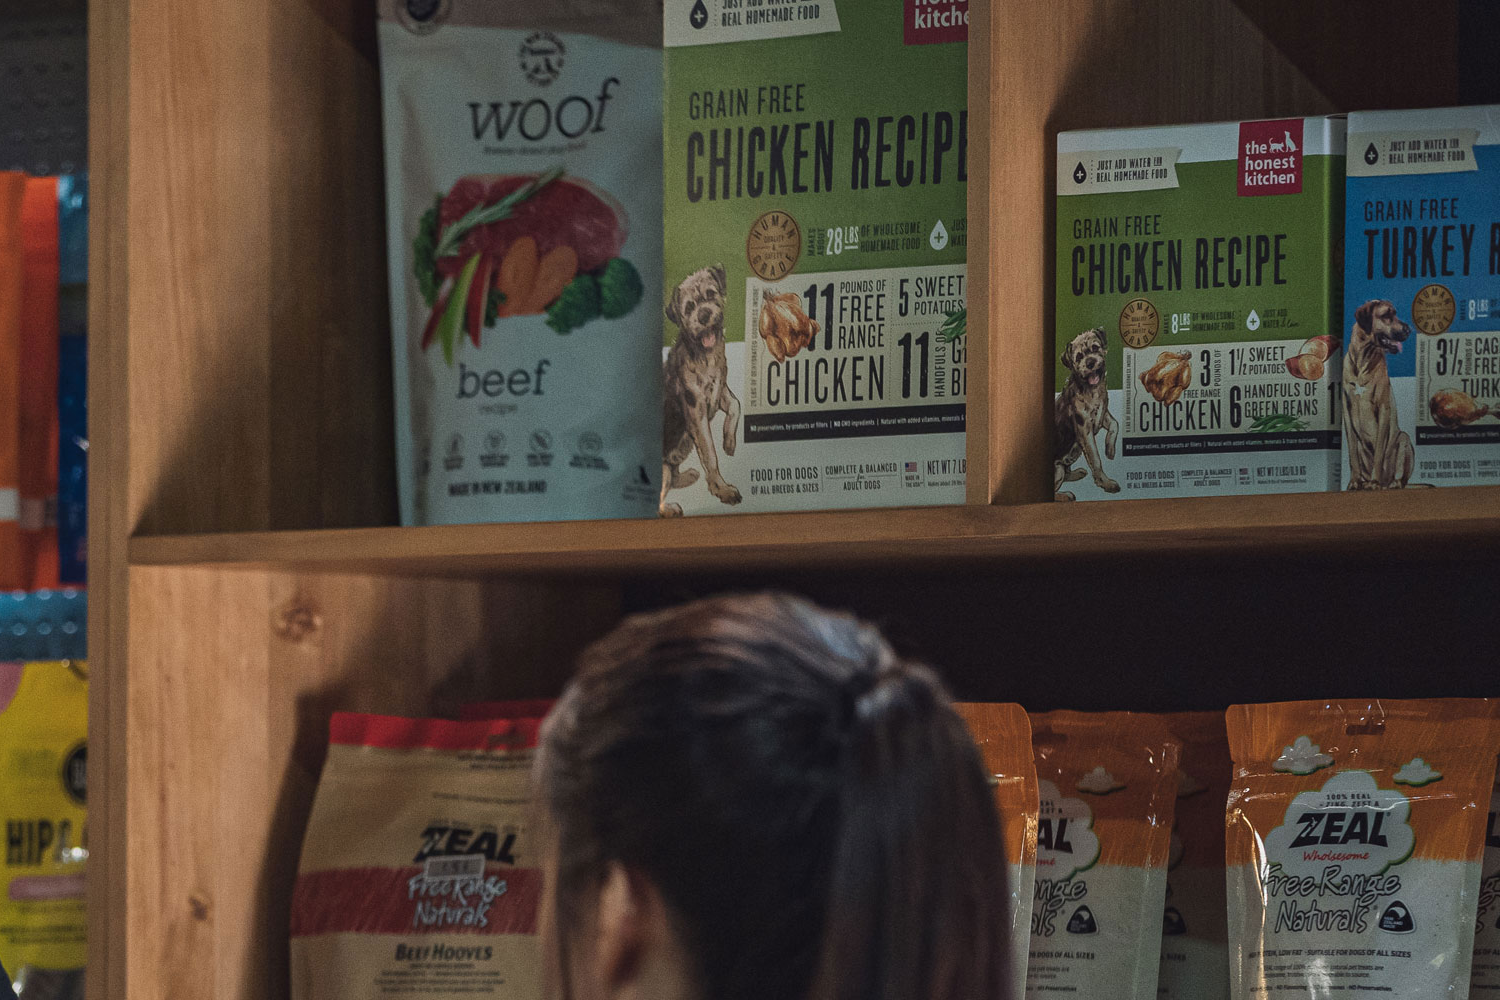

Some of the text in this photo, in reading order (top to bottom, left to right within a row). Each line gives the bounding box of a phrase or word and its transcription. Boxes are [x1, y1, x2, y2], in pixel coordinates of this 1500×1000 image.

[722, 5, 820, 27] REAL HOMEMADE FOOD
[467, 77, 620, 141] woof
[689, 84, 806, 121] GRAIN FREE
[1245, 141, 1267, 155] the
[1389, 139, 1447, 152] JUST ADD WATER
[687, 119, 834, 203] CHICKEN
[1097, 157, 1151, 170] JUST ADD WATER
[1245, 155, 1295, 171] honest
[1389, 151, 1465, 164] REAL HOMEMADE FOOD
[1097, 169, 1167, 182] REAL HOMEMADE FOOD
[1245, 171, 1295, 186] kitchen
[1364, 198, 1459, 222] GRAIN FREE
[753, 215, 796, 241] HUMAN
[844, 225, 859, 244] LBS
[861, 221, 921, 236] OF WHOLESOME
[1073, 215, 1161, 239] GRAIN FREE
[826, 227, 843, 255] 28
[860, 237, 921, 253] HOMEMADE FOOD
[1364, 224, 1475, 280] TURKEY
[752, 254, 796, 278] GRADE
[1072, 234, 1287, 297] CHICKEN RECIPE
[840, 279, 886, 293] POUNDS OF
[914, 275, 964, 298] SWEET
[1418, 288, 1451, 305] HUMAN
[899, 279, 909, 317] 5
[914, 299, 964, 316] POTATOES
[804, 283, 835, 351] 11
[839, 294, 886, 324] FREE
[1124, 303, 1155, 320] HUMAN
[1179, 312, 1190, 326] LBS
[1469, 299, 1475, 320] 8
[1171, 313, 1178, 334] 8
[838, 324, 885, 349] RANGE
[1124, 329, 1154, 345] GRADE
[1214, 350, 1221, 359] OF
[1249, 346, 1286, 361] SWEET
[898, 331, 930, 399] 11
[935, 345, 945, 398] HANDFULS
[1201, 350, 1211, 387] 3
[1249, 362, 1286, 375] POTATOES
[457, 359, 550, 399] beef
[767, 355, 885, 406] CHICKEN
[1183, 388, 1221, 399] FREE RANGE
[1245, 382, 1318, 399] HANDFULS OF
[1140, 400, 1221, 432] CHICKEN
[1229, 385, 1241, 428] 6
[1245, 399, 1318, 418] GREEN BEANS
[751, 466, 818, 481] FOOD FOR DOGS
[825, 463, 897, 475] COMPLETE & BALANCED
[928, 460, 956, 475] NET WT 7
[1126, 470, 1175, 480] FOOD FOR DOGS
[751, 486, 758, 495] OF
[760, 485, 770, 494] ALL
[772, 484, 794, 494] BREEDS
[802, 483, 819, 492] SIZES
[843, 480, 880, 490] ADULT DOGS
[1288, 811, 1389, 849] ZEAL
[5, 819, 51, 867] HIP
[413, 825, 516, 865] ZEAL
[1262, 863, 1402, 906] Free Range
[413, 900, 491, 928] Naturals
[1275, 899, 1370, 934] Naturals
[1063, 951, 1074, 959] ALL
